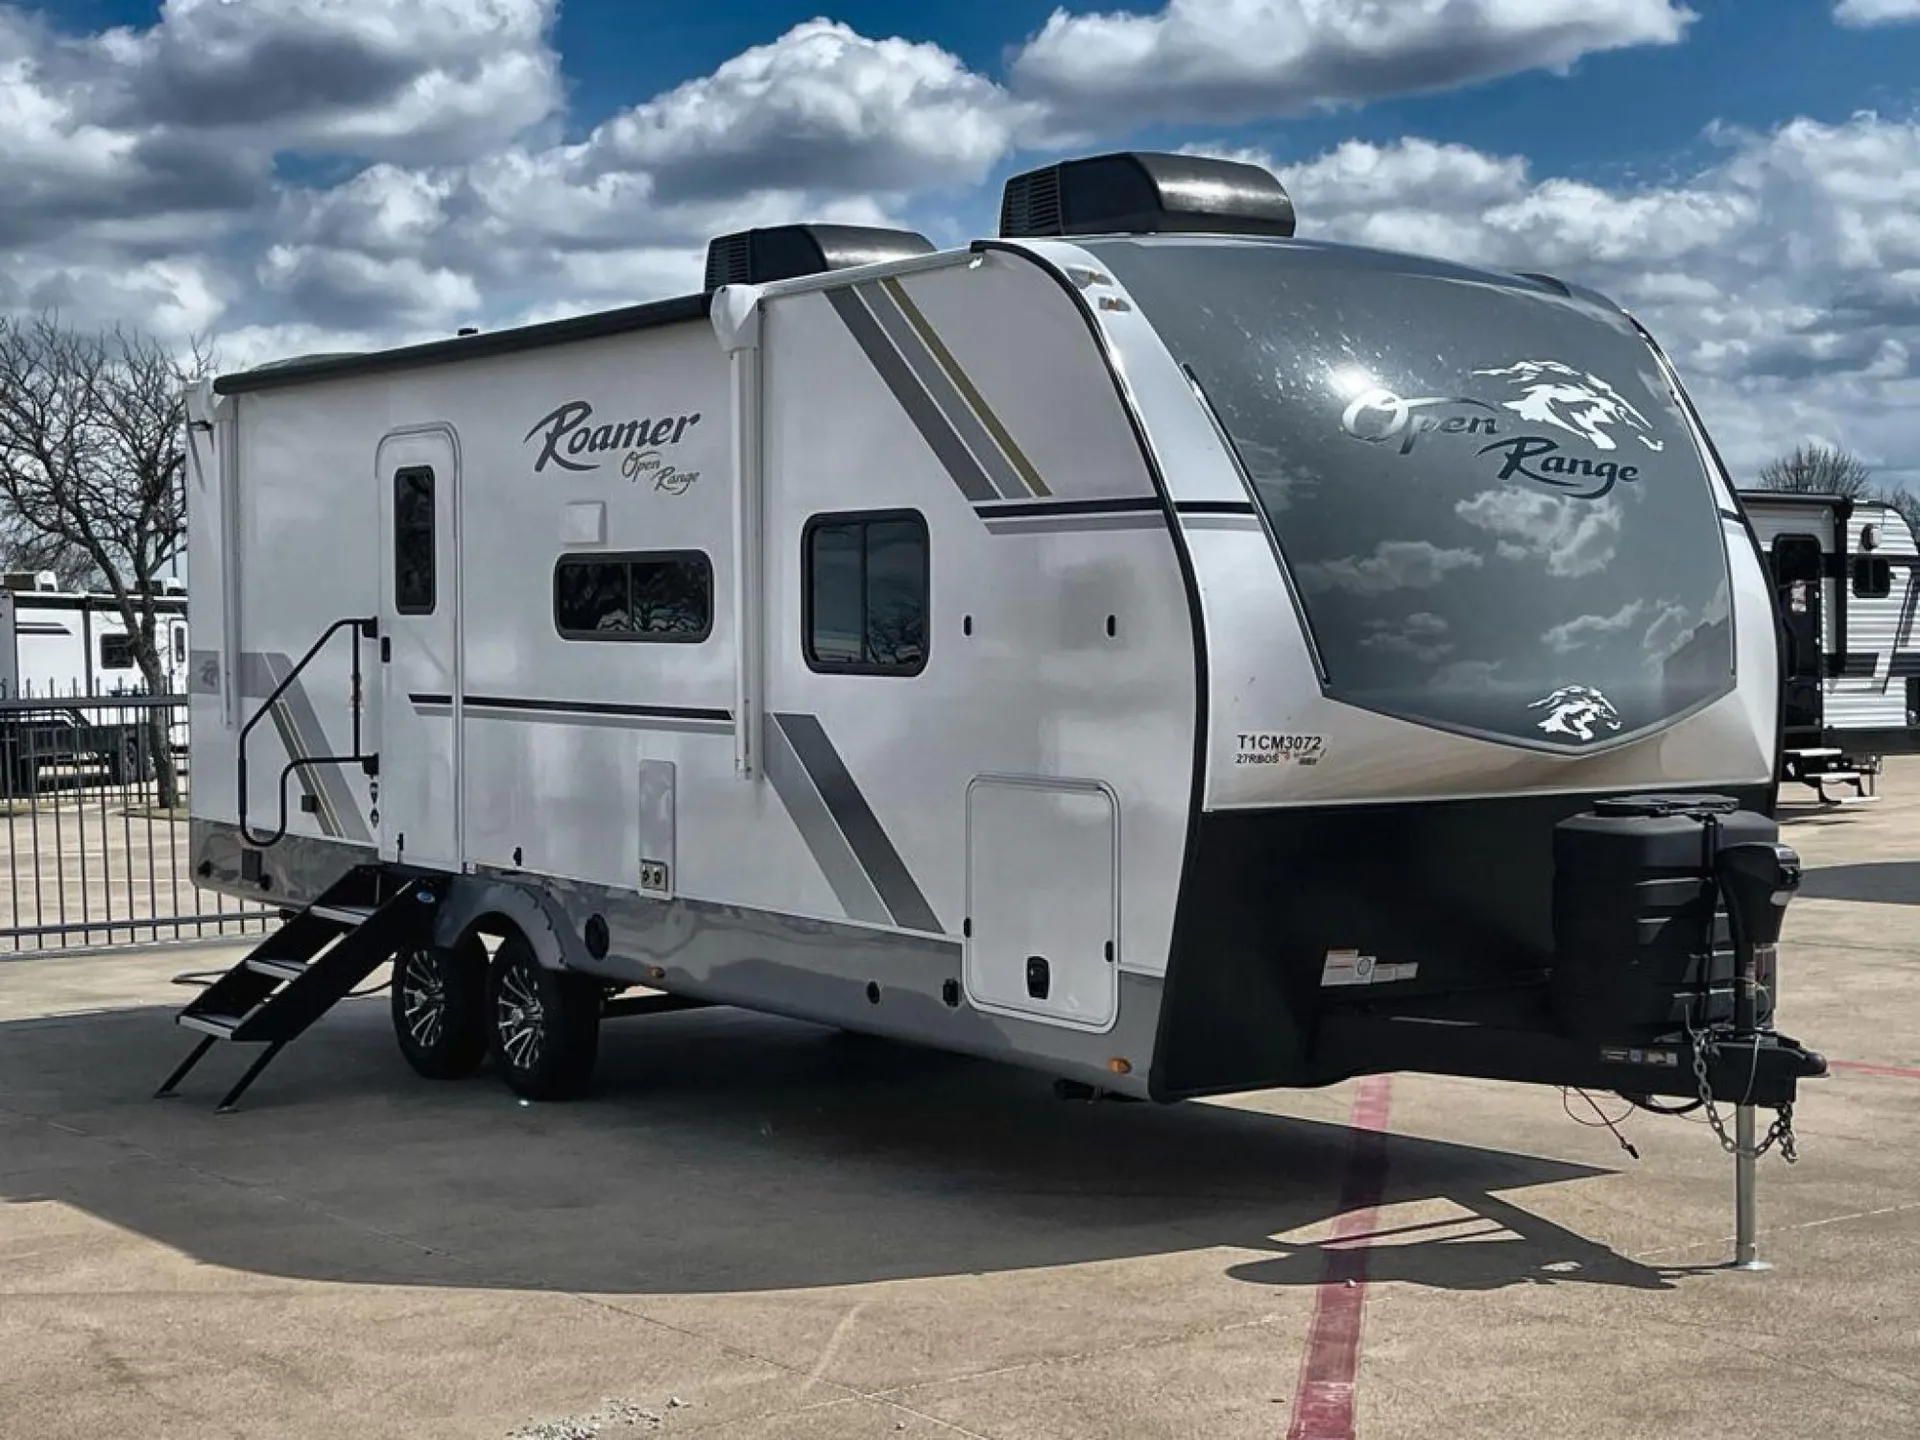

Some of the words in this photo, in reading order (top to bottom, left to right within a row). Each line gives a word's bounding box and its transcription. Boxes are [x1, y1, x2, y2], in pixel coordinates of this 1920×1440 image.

[523, 401, 701, 473] Roamer
[1342, 388, 1499, 455] Open
[622, 451, 662, 483] Open
[651, 466, 700, 496] Range
[1475, 436, 1639, 500] Range
[1237, 734, 1323, 751] T1CM3072
